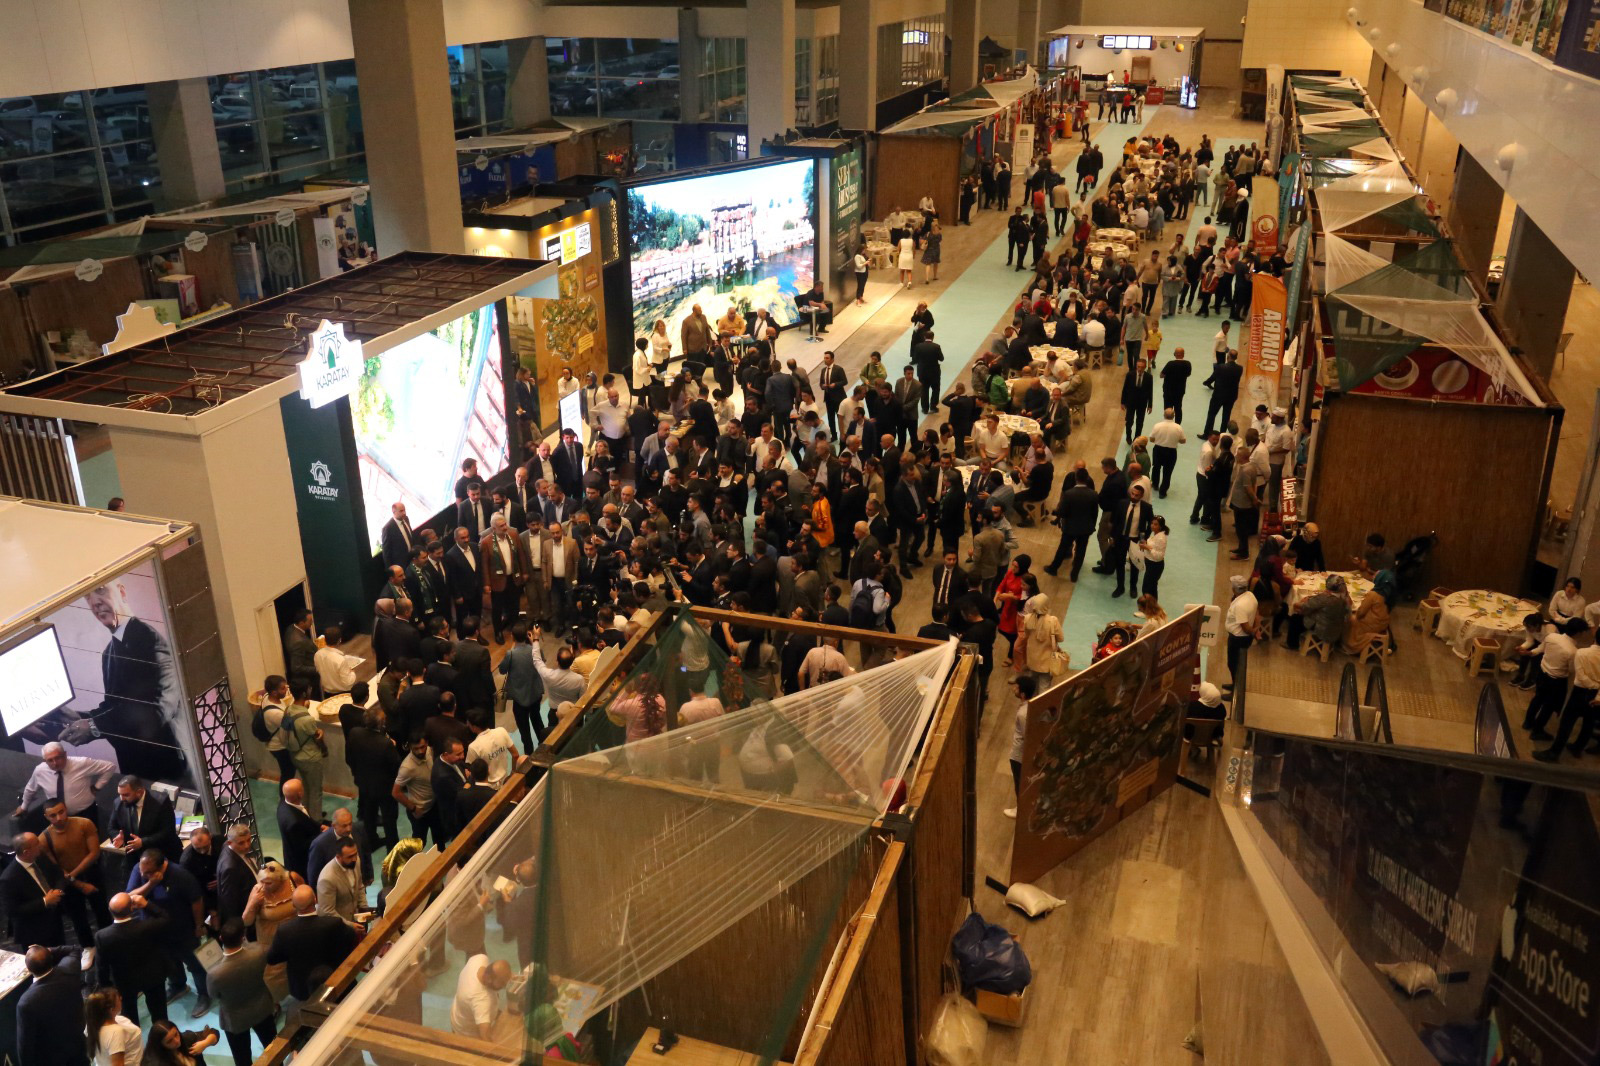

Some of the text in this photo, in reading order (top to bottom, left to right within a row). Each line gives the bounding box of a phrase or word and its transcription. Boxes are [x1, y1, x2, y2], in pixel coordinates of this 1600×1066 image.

[316, 366, 350, 391] KARATAY
[308, 485, 339, 497] KARATAY
[1518, 932, 1548, 995] App
[1547, 949, 1590, 1018] Store
